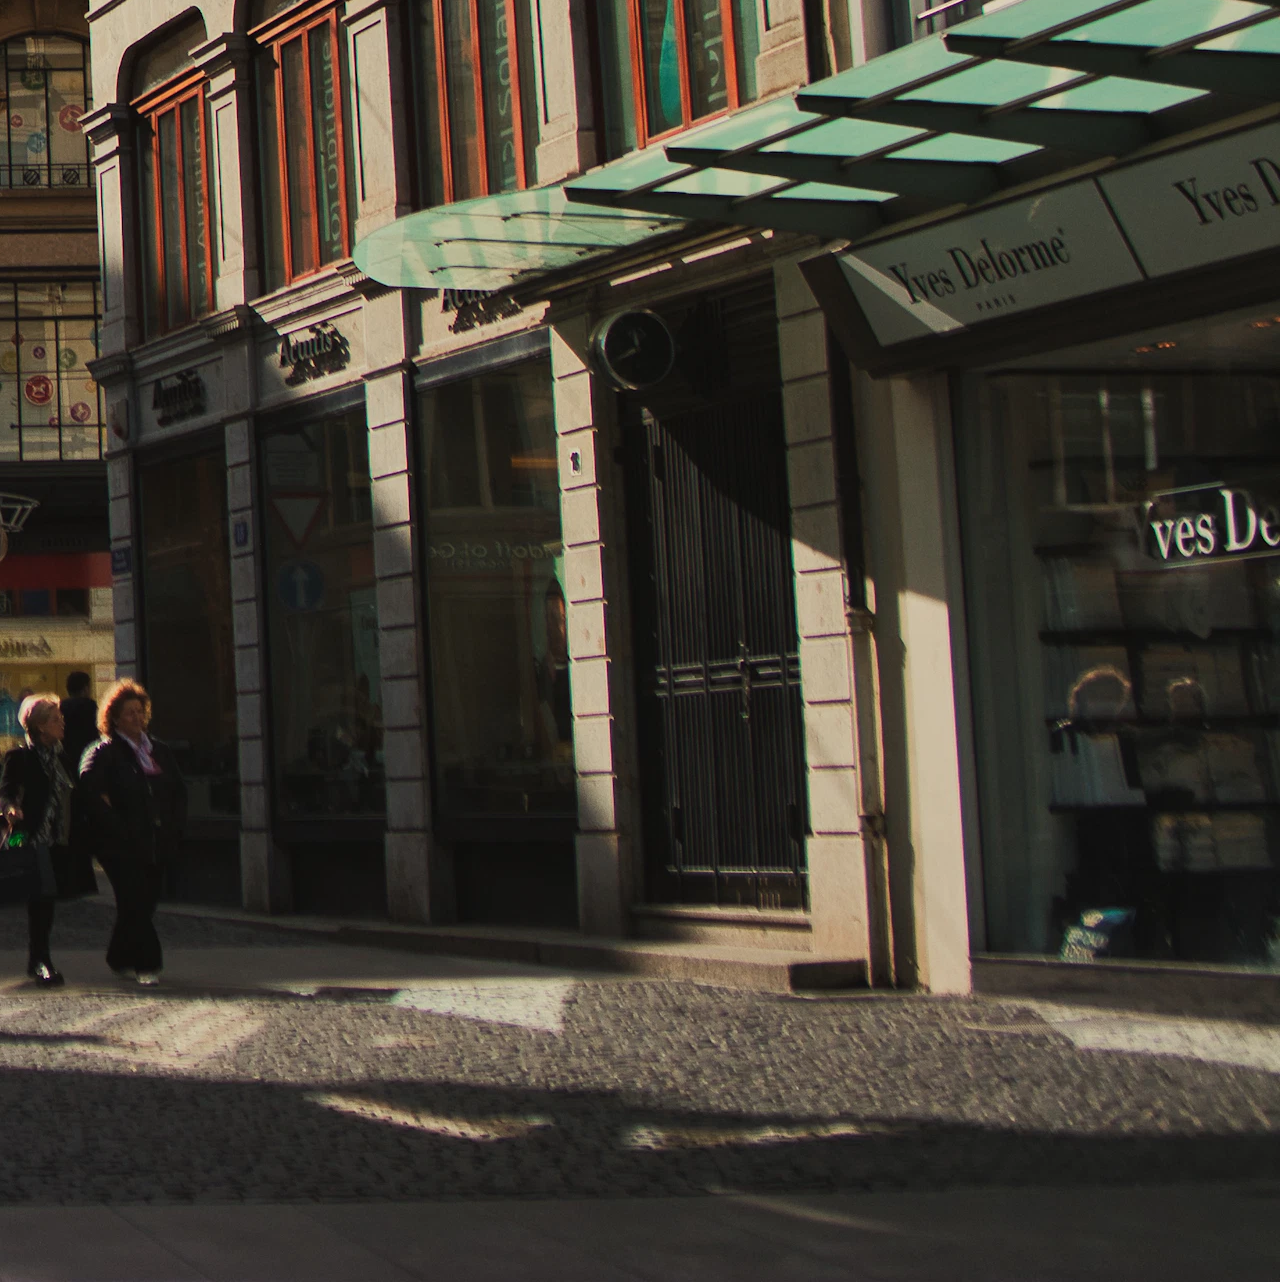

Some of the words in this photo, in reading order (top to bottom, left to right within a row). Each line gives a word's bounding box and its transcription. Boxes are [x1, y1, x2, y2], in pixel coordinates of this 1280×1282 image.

[1171, 177, 1259, 225] Yves
[888, 262, 957, 305] Yves
[947, 237, 1071, 291] Delorme
[975, 293, 1017, 312] PARIS
